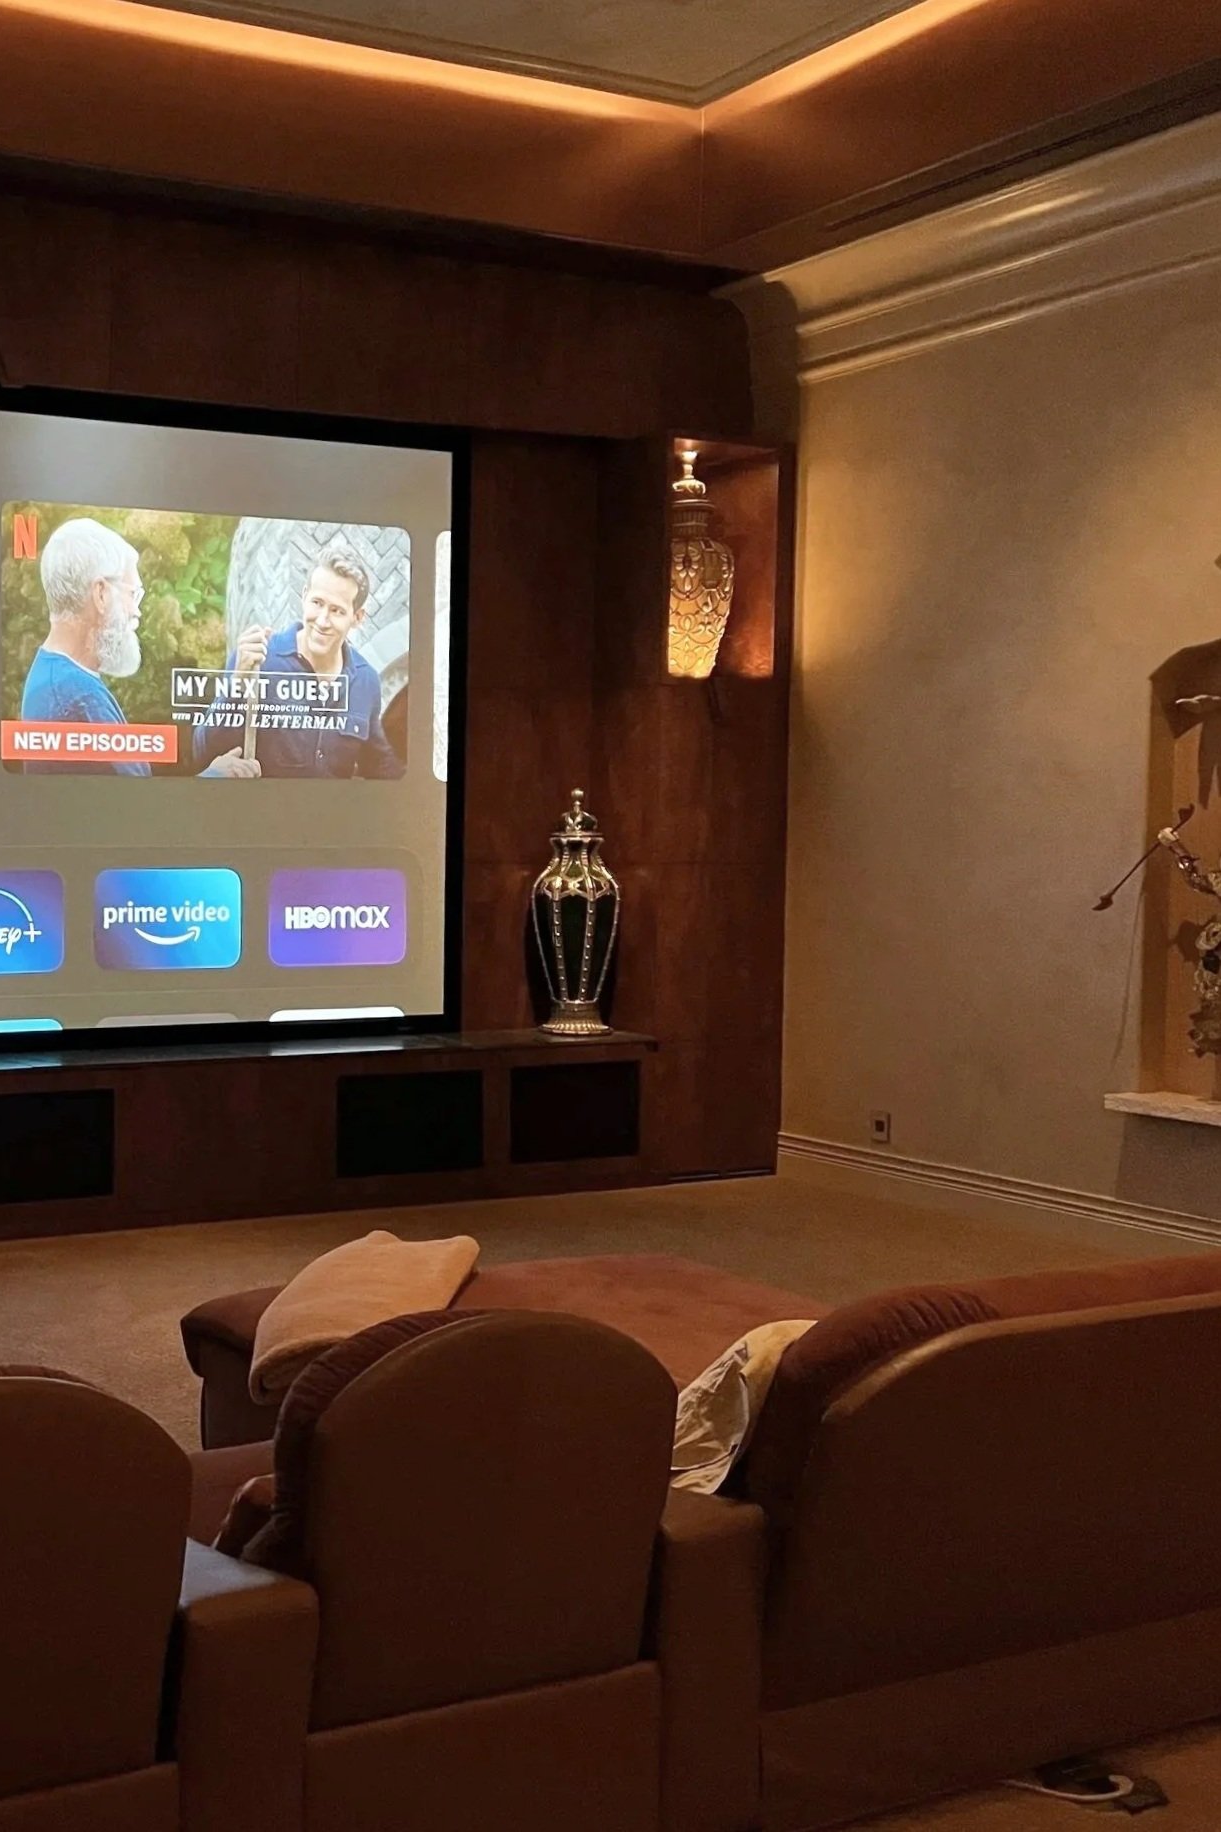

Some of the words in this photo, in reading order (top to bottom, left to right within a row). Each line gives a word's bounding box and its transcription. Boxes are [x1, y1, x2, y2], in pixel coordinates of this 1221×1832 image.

[13, 514, 38, 560] N
[177, 675, 208, 697] MY
[215, 677, 269, 700] NEXT
[276, 679, 342, 702] GUEST
[210, 702, 236, 711] NEEDS
[237, 703, 249, 712] NO
[251, 704, 310, 713] INTRODUCTION
[192, 712, 245, 728] DAVID
[250, 713, 348, 730] LETTERMAN
[14, 731, 61, 750] NEW
[66, 733, 166, 753] EPISODES
[103, 901, 168, 929] prime
[171, 901, 230, 923] video
